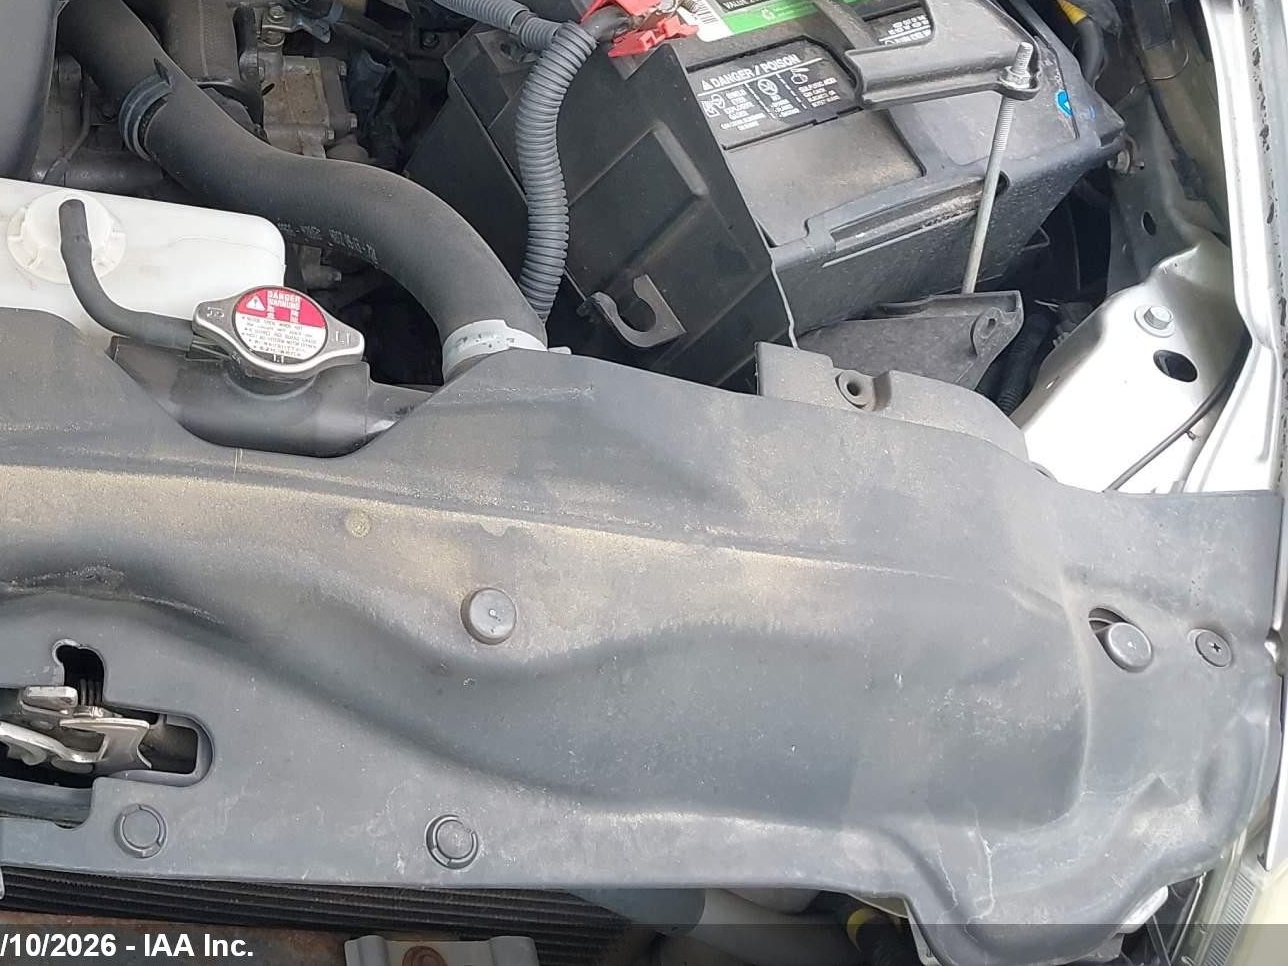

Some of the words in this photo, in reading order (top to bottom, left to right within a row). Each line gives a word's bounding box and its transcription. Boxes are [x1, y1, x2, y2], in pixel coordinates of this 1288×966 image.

[709, 67, 755, 88] DANGER
[761, 53, 803, 74] POISON
[267, 290, 301, 303] DANGER
